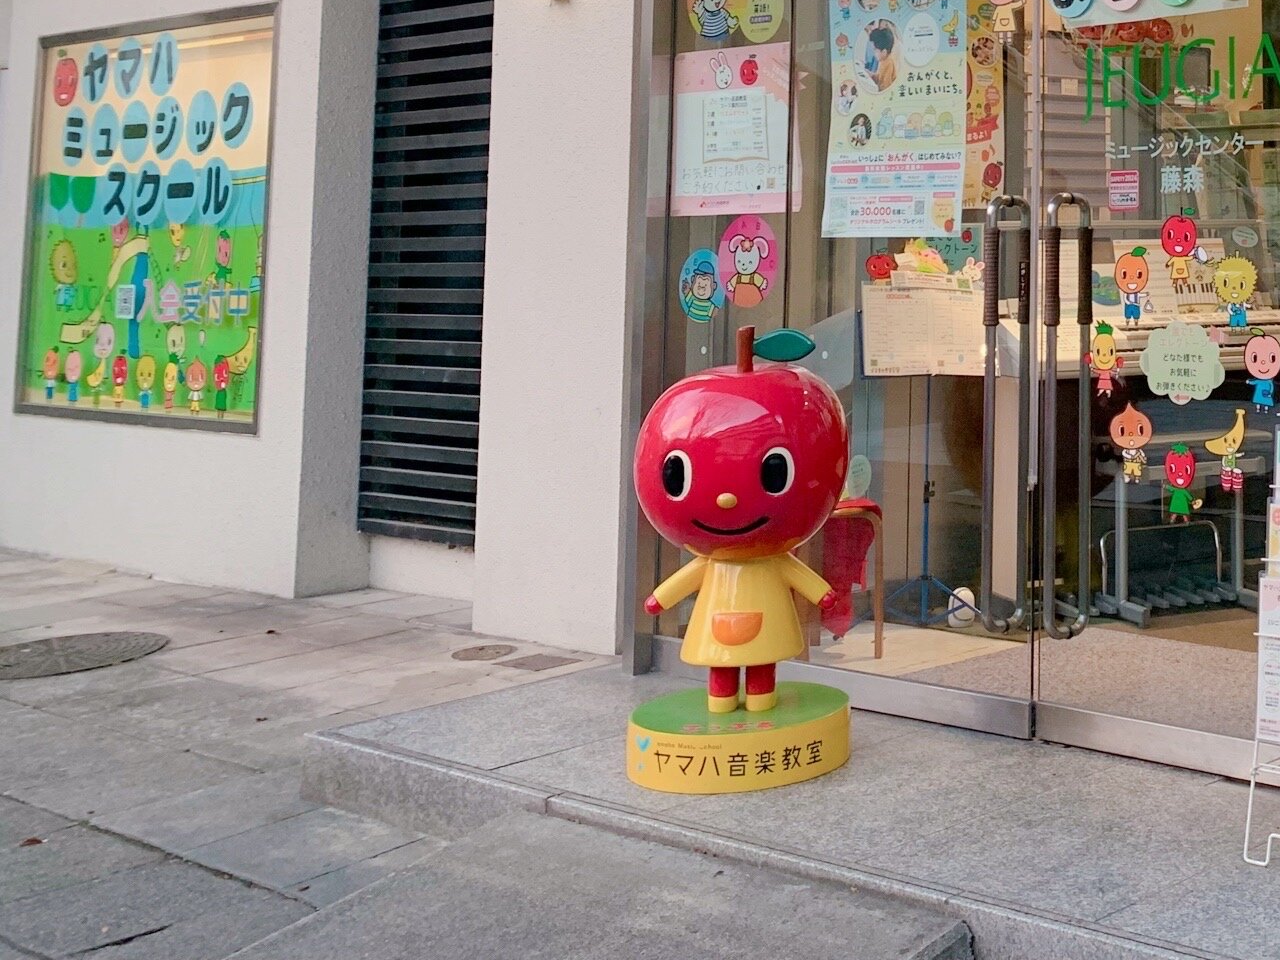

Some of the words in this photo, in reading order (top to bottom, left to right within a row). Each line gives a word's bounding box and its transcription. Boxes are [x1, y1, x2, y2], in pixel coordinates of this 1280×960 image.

[83, 41, 174, 101] ヤマハ
[64, 92, 249, 159] ミュージック
[1105, 131, 1264, 160] ミュージックセンター
[103, 166, 230, 217] スクール
[1160, 166, 1205, 194] 藤森
[136, 278, 250, 327] 入会受付中
[654, 740, 823, 777] ヤマハ音楽教室
